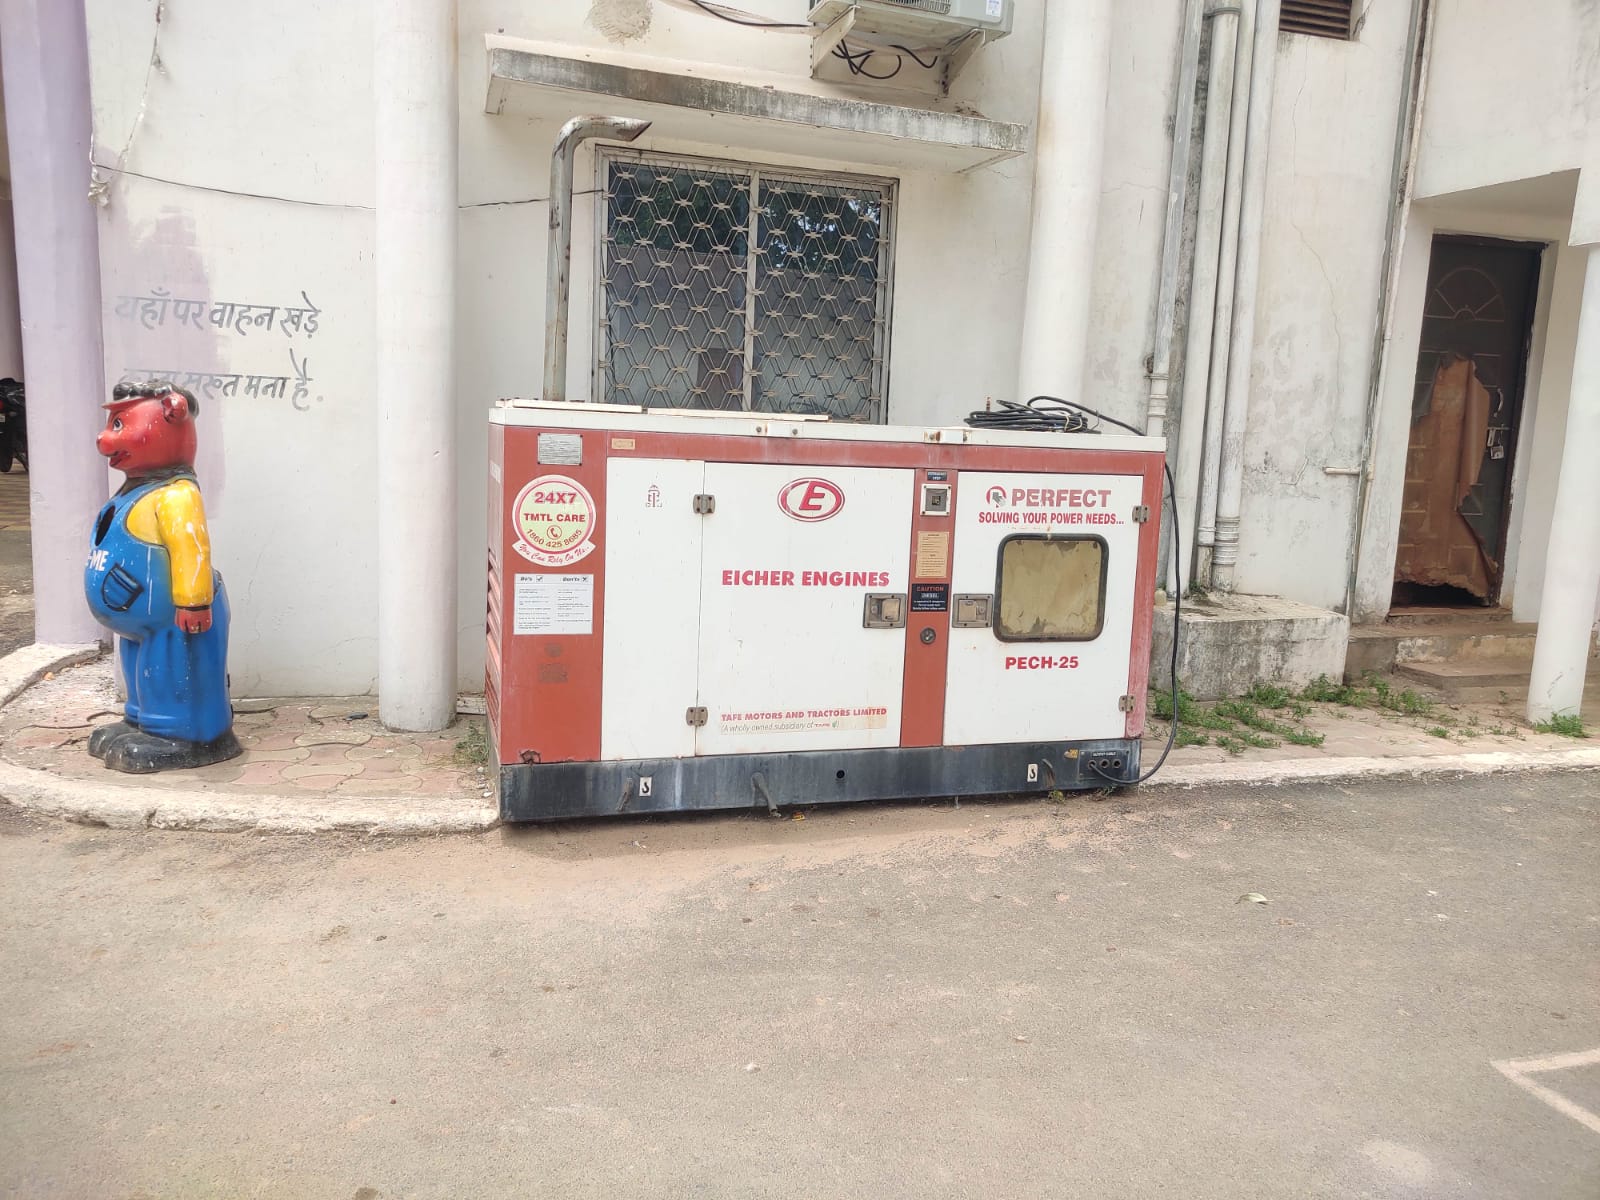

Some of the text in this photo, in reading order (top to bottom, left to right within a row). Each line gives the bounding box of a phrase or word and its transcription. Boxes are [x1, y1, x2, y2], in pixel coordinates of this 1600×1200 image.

[172, 298, 207, 330] पर
[208, 301, 281, 336] वाहन
[279, 289, 322, 338] खड़े
[243, 374, 291, 399] मना
[534, 491, 577, 504] 24X7
[1011, 488, 1111, 508] PERFECT
[523, 512, 586, 523] TMTL CARE
[978, 511, 1019, 524] SOLVING
[1022, 512, 1047, 524] YOUR
[1050, 513, 1083, 524] POWER
[526, 528, 545, 545] 1860
[563, 528, 582, 546] 8685
[530, 552, 545, 562] Can
[721, 570, 889, 587] EICHER ENGINES
[1005, 656, 1079, 670] PECH-25
[721, 708, 887, 722] TAFE MOTORS AND TRACTORS LIMITED
